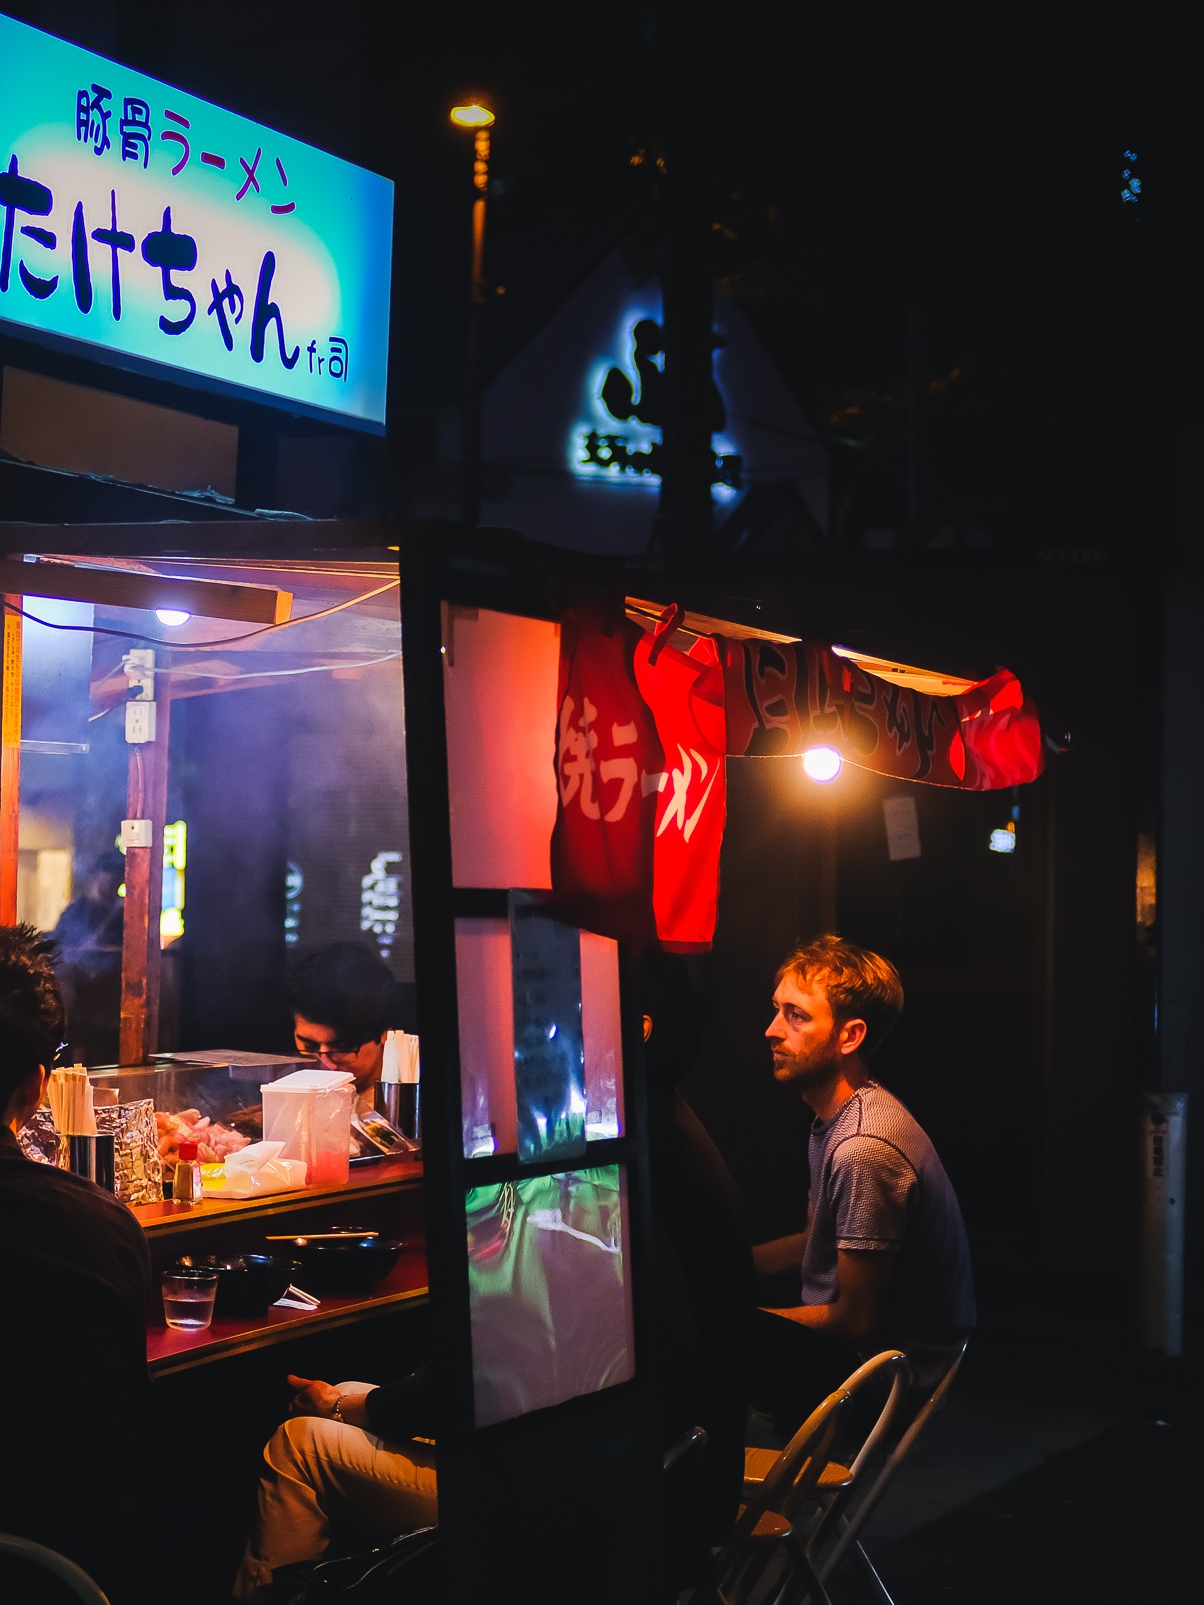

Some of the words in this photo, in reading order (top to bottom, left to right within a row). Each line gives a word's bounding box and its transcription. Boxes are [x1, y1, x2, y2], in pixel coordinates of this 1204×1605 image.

[76, 82, 296, 215] 豚骨ラーメン
